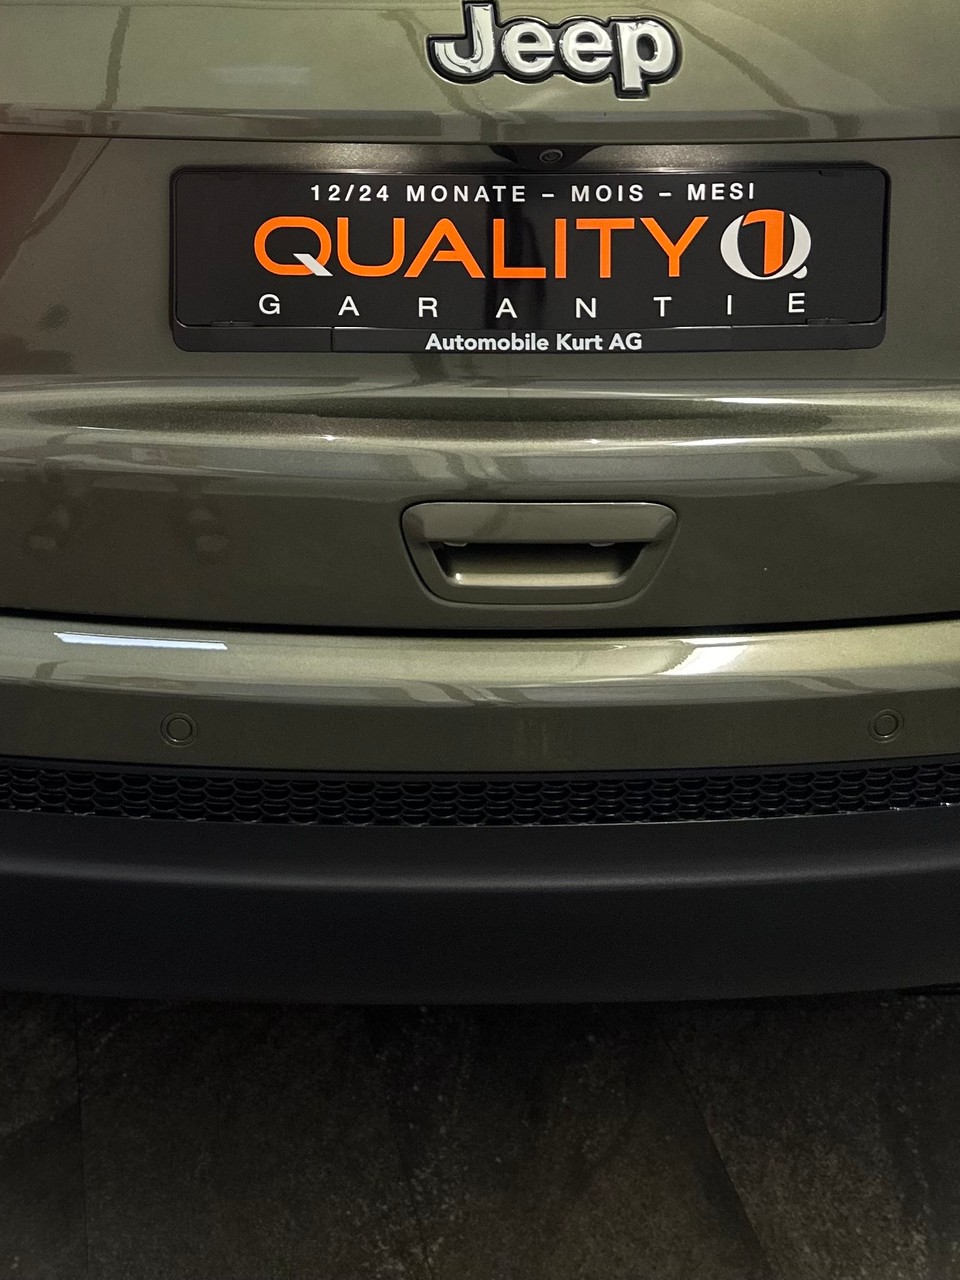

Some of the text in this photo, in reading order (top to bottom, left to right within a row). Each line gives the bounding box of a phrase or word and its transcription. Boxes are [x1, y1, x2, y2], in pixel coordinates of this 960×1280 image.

[429, 1, 680, 97] Jeep
[310, 183, 389, 202] 12/24
[406, 184, 526, 203] MONATE
[571, 184, 644, 203] MOIS
[687, 182, 755, 201] MESI
[253, 215, 709, 279] QUALITY
[258, 292, 806, 319] GARANTIE
[424, 332, 642, 352] Automobile Kurt AG
